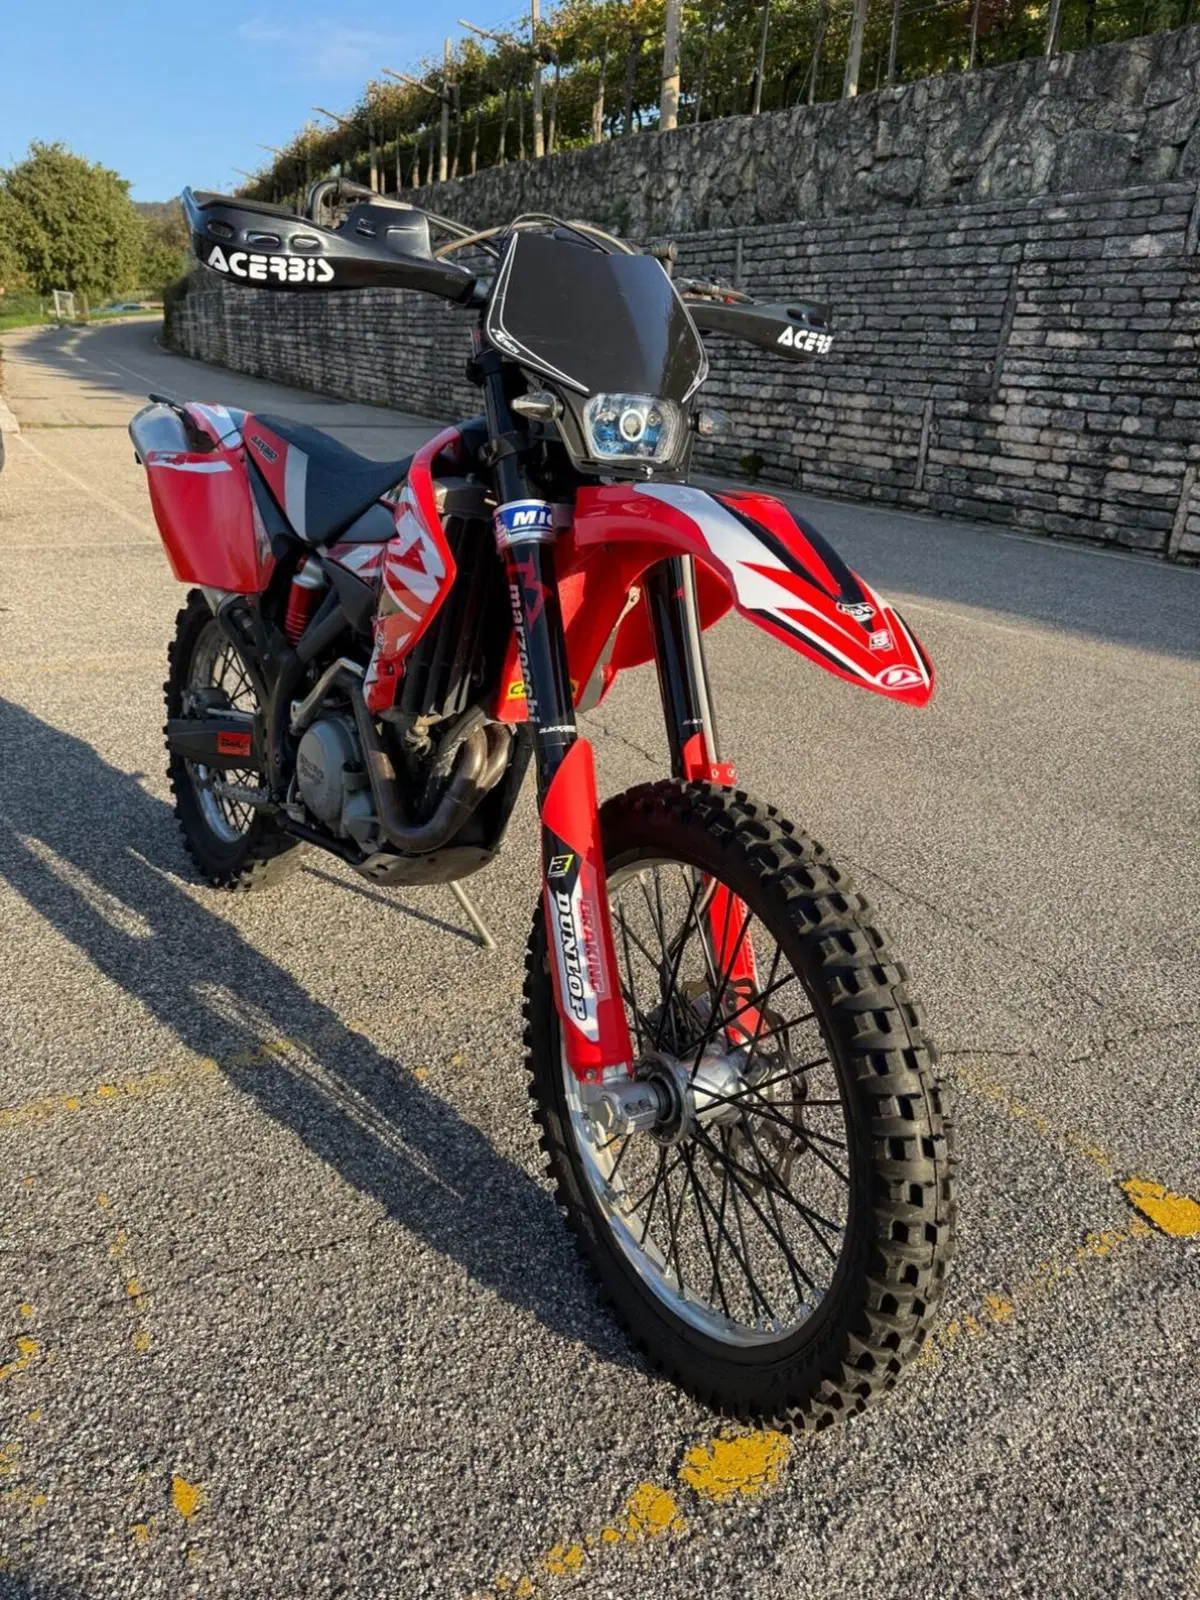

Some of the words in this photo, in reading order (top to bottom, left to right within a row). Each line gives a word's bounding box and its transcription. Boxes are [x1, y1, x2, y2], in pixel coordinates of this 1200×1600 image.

[777, 325, 835, 354] ACERB
[509, 584, 541, 722] marzocchi
[556, 890, 587, 1021] DUNLOP
